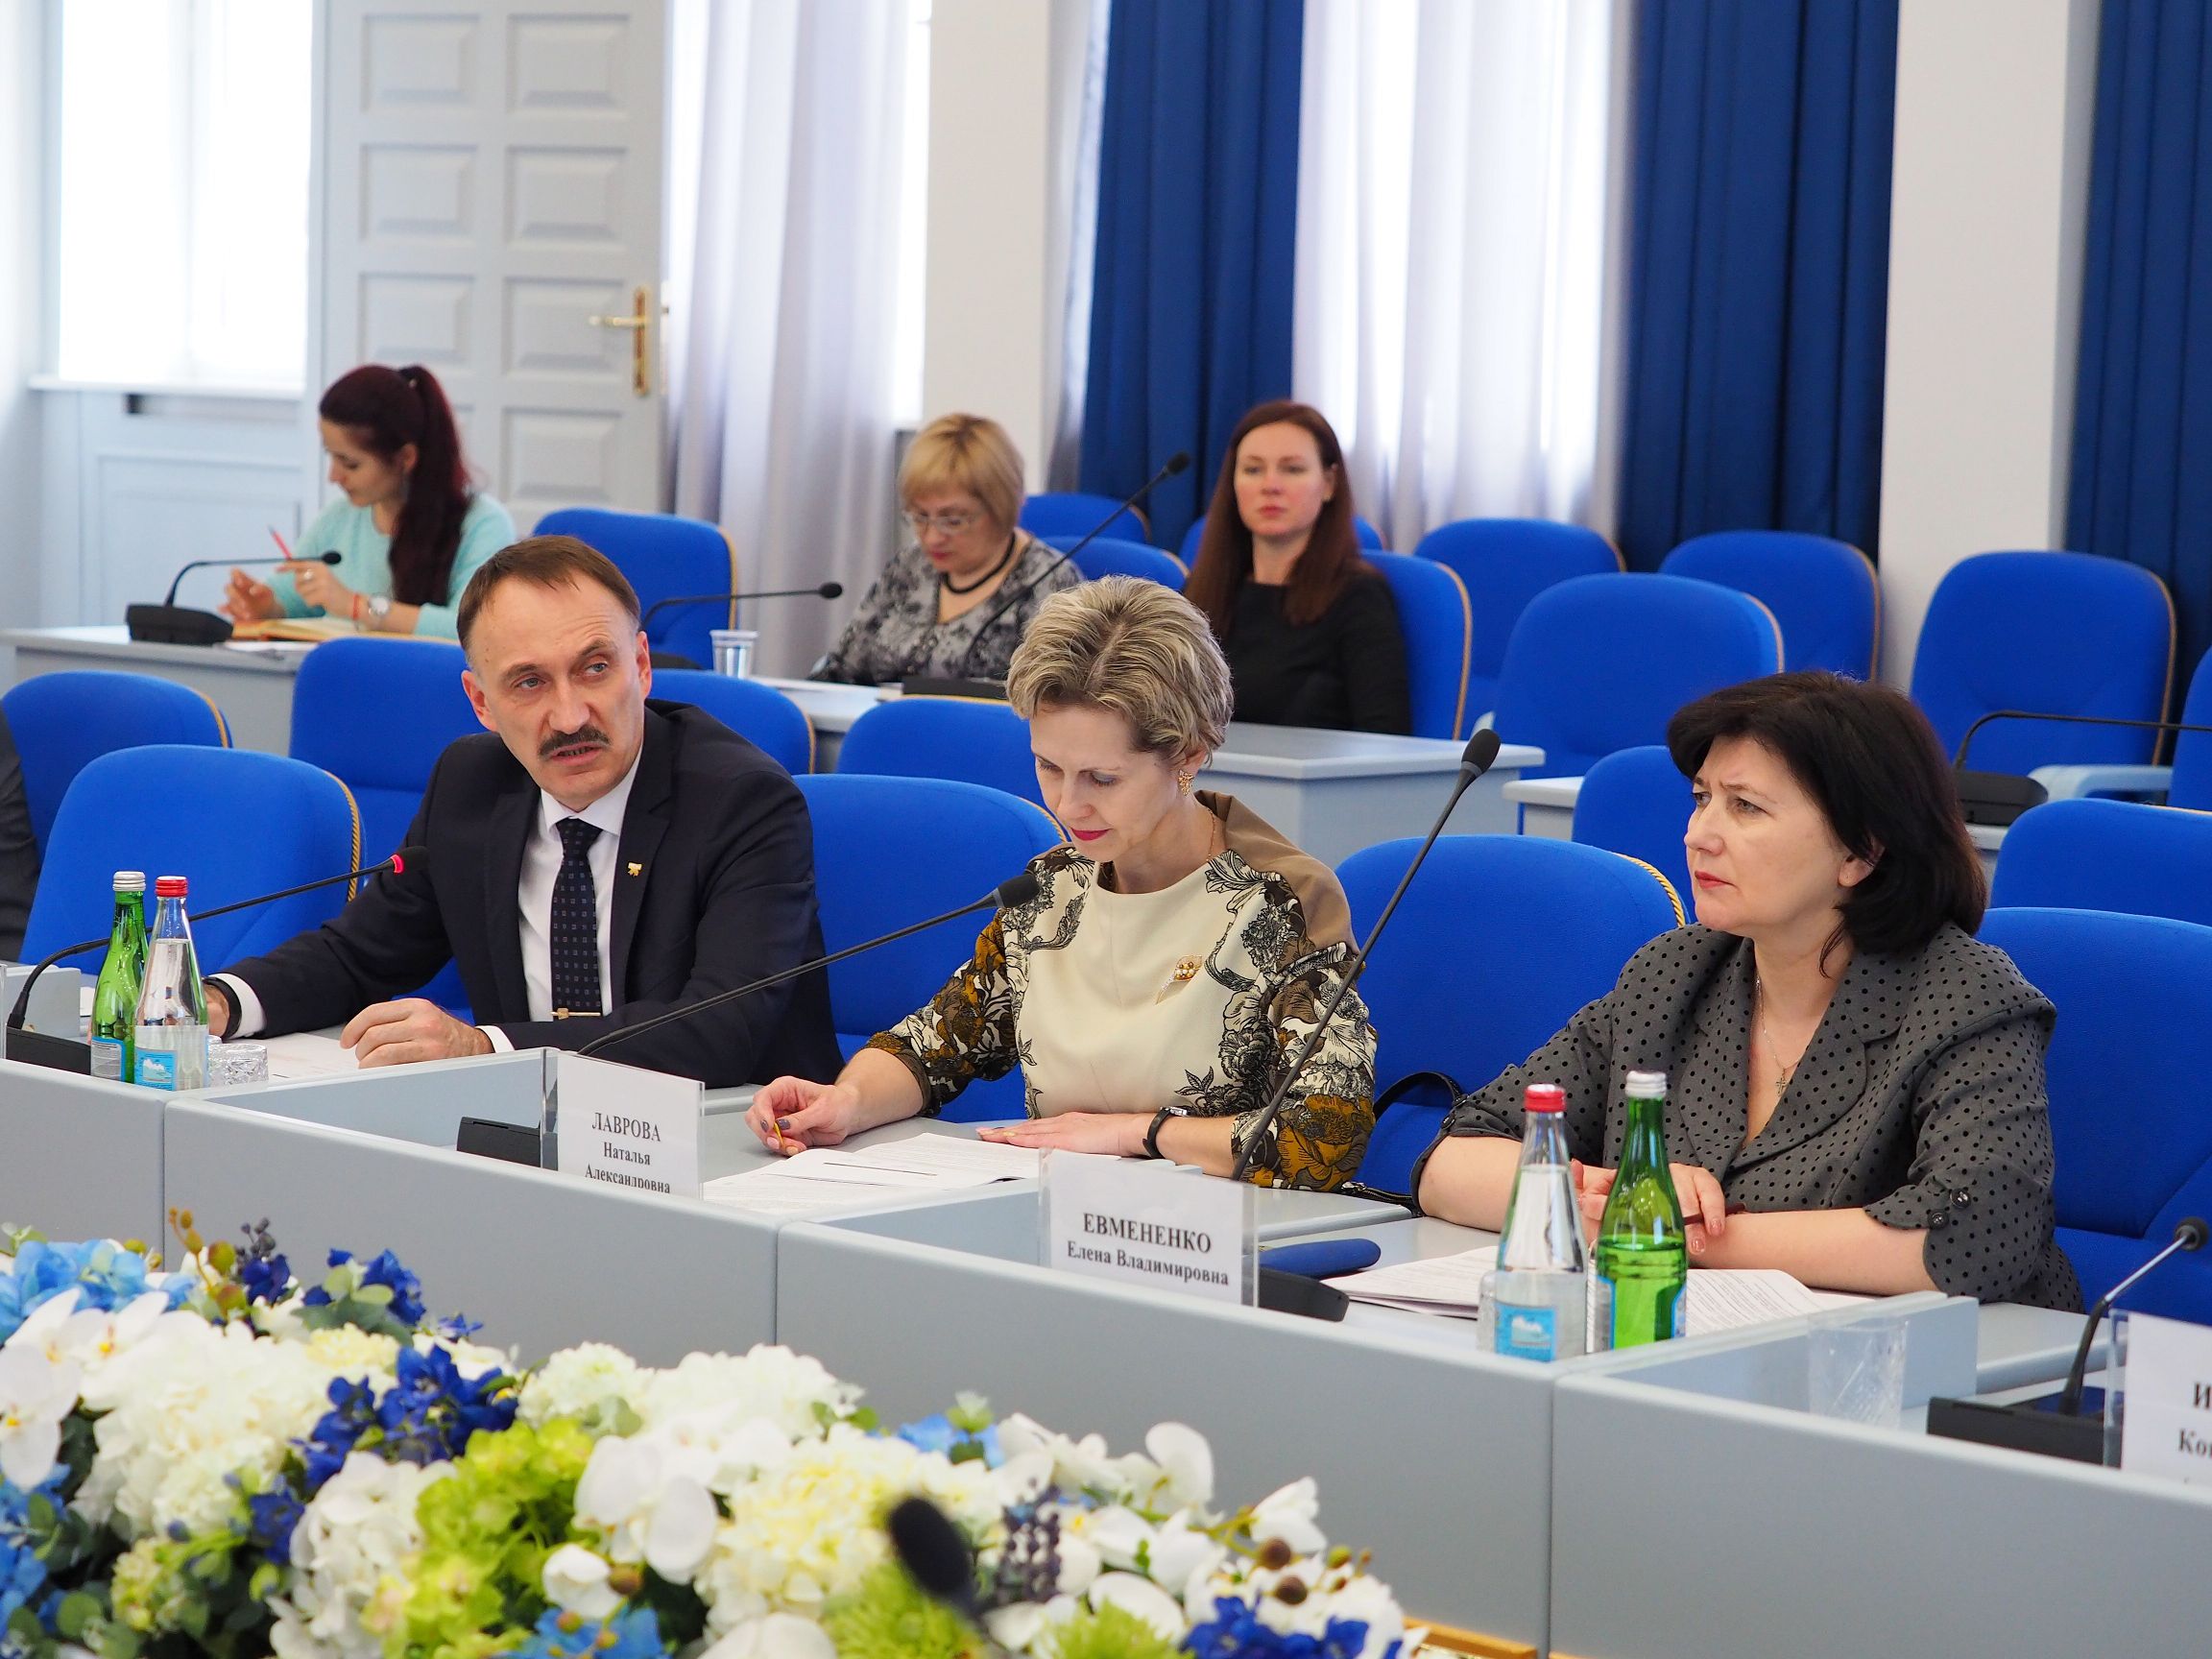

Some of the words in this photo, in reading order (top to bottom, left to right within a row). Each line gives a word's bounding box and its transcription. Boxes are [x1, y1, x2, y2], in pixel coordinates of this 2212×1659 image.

[591, 1112, 661, 1142] ЛАВРОВА
[603, 1141, 651, 1166] Наталья
[1083, 1212, 1212, 1254] ЕВМЕНЕНКО
[1067, 1239, 1112, 1264] Елена
[1117, 1248, 1229, 1286] Владимировна
